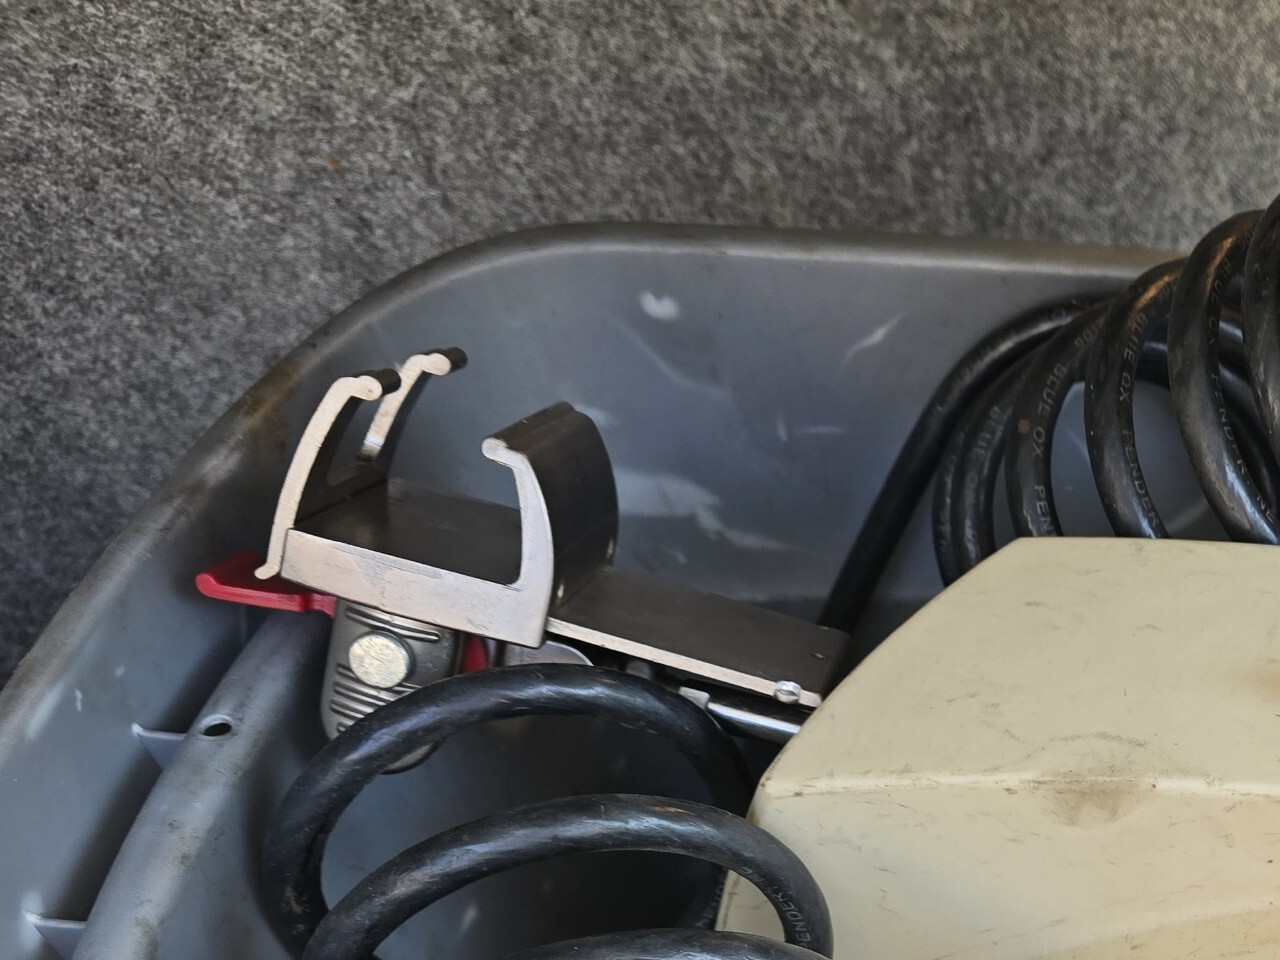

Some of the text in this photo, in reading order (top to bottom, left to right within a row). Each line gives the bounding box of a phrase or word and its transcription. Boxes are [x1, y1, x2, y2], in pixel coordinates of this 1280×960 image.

[1037, 363, 1068, 416] BLUE
[1120, 371, 1131, 402] OX
[1031, 427, 1046, 458] OX
